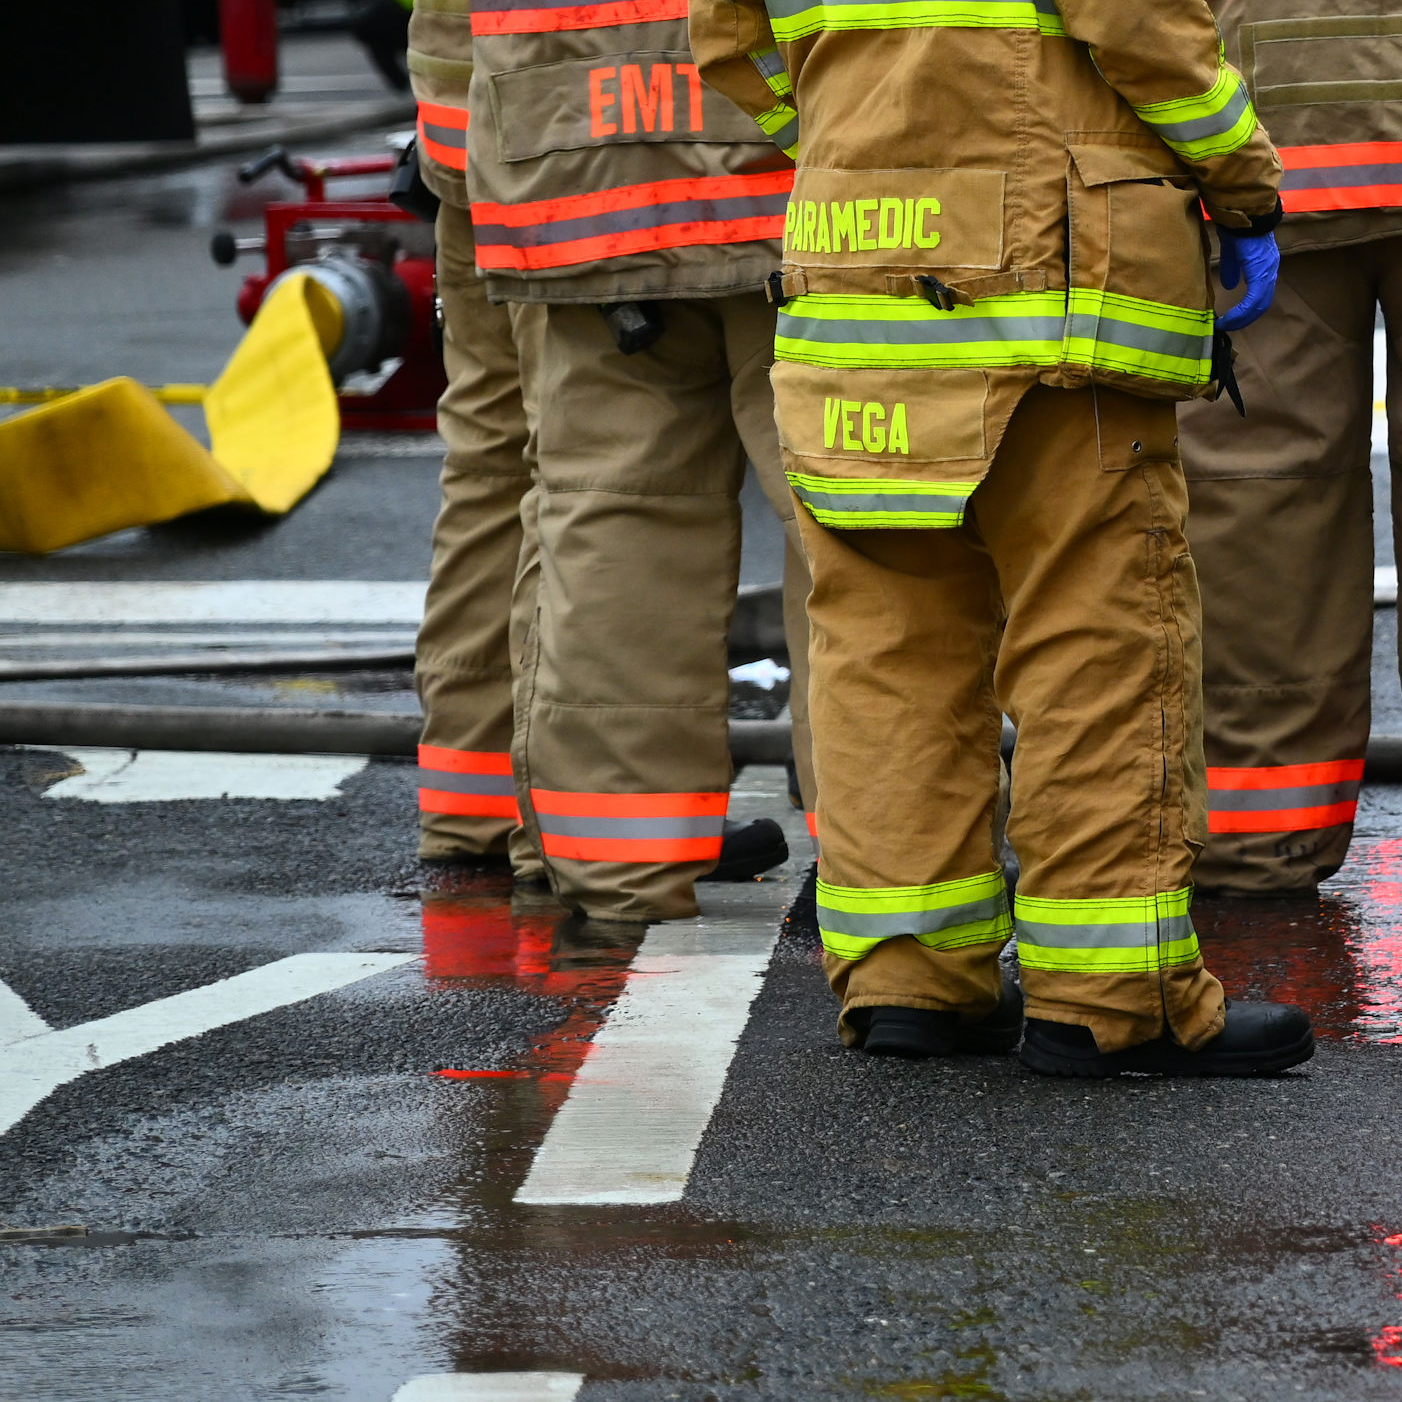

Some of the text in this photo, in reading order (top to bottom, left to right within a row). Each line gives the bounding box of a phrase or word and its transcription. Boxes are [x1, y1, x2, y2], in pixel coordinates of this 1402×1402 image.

[589, 63, 703, 137] EMT
[785, 197, 941, 254] PARAMEDIC
[824, 397, 909, 454] VEGA
